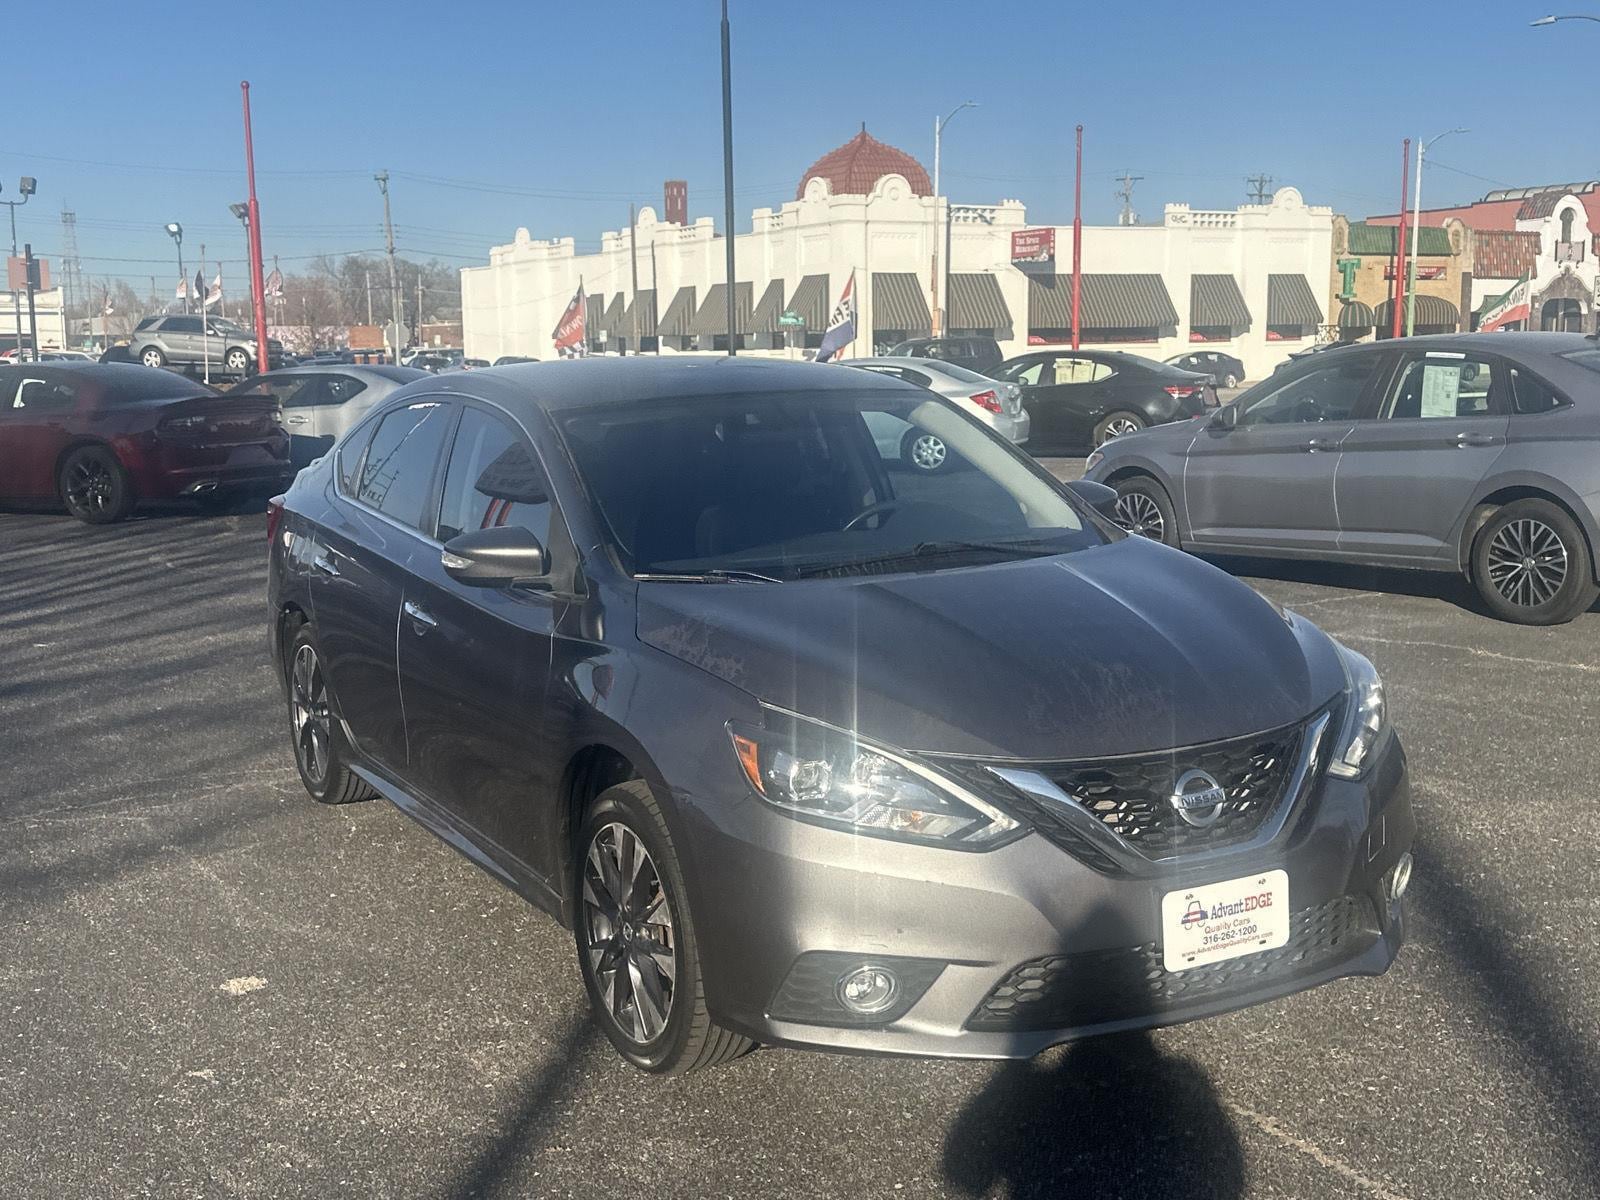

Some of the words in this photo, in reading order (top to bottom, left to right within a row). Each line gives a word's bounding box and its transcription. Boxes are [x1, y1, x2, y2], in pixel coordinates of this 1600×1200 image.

[1181, 791, 1223, 807] NISSAN
[1210, 892, 1273, 920] AdvantEDGE
[1203, 924, 1258, 945] 316-262-1200
[1204, 921, 1232, 935] Quality
[1233, 917, 1250, 928] Cars
